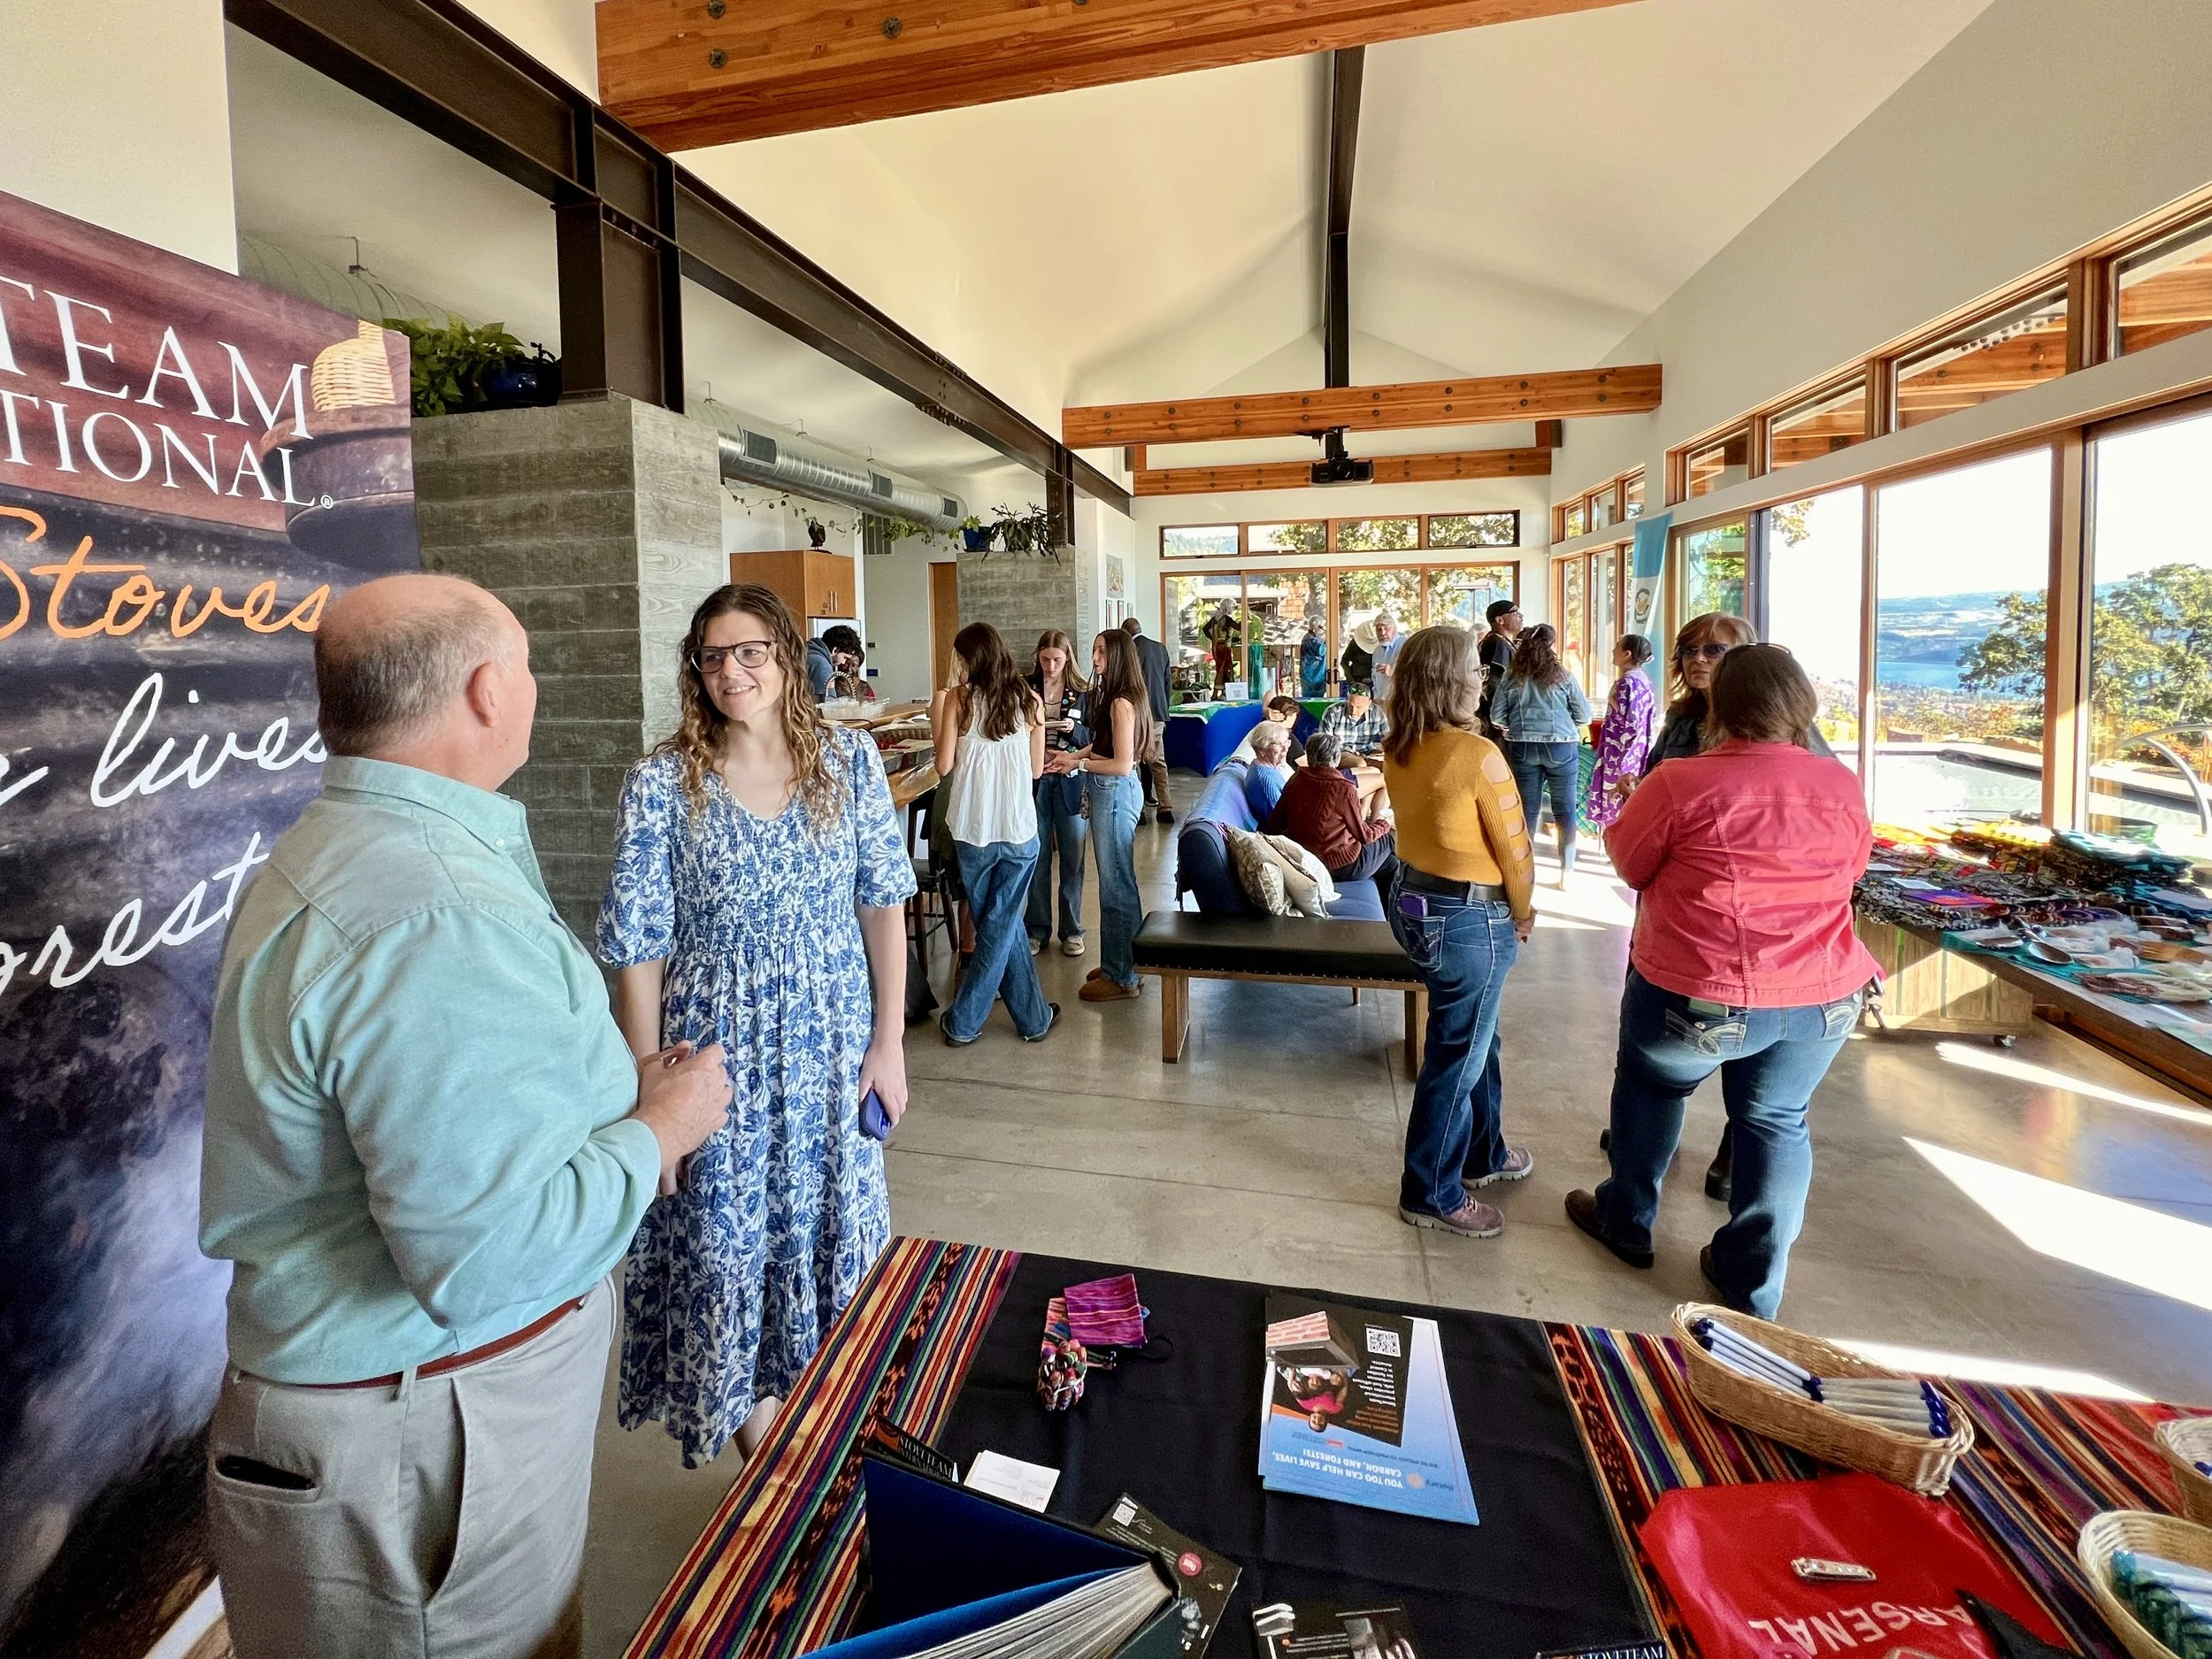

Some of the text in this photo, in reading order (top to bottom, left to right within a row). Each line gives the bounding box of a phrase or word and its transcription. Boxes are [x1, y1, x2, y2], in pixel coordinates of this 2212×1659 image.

[90, 672, 328, 807] lives
[1298, 1457, 1321, 1470] SAVE
[1322, 1464, 1344, 1476] HELP
[1343, 1458, 1362, 1470] AND
[1363, 1462, 1402, 1478] CARBON,
[1345, 1470, 1363, 1480] CAN
[1364, 1473, 1384, 1486] TOO
[1384, 1477, 1403, 1489] YOU
[1747, 1601, 1975, 1655] ARSENAL
